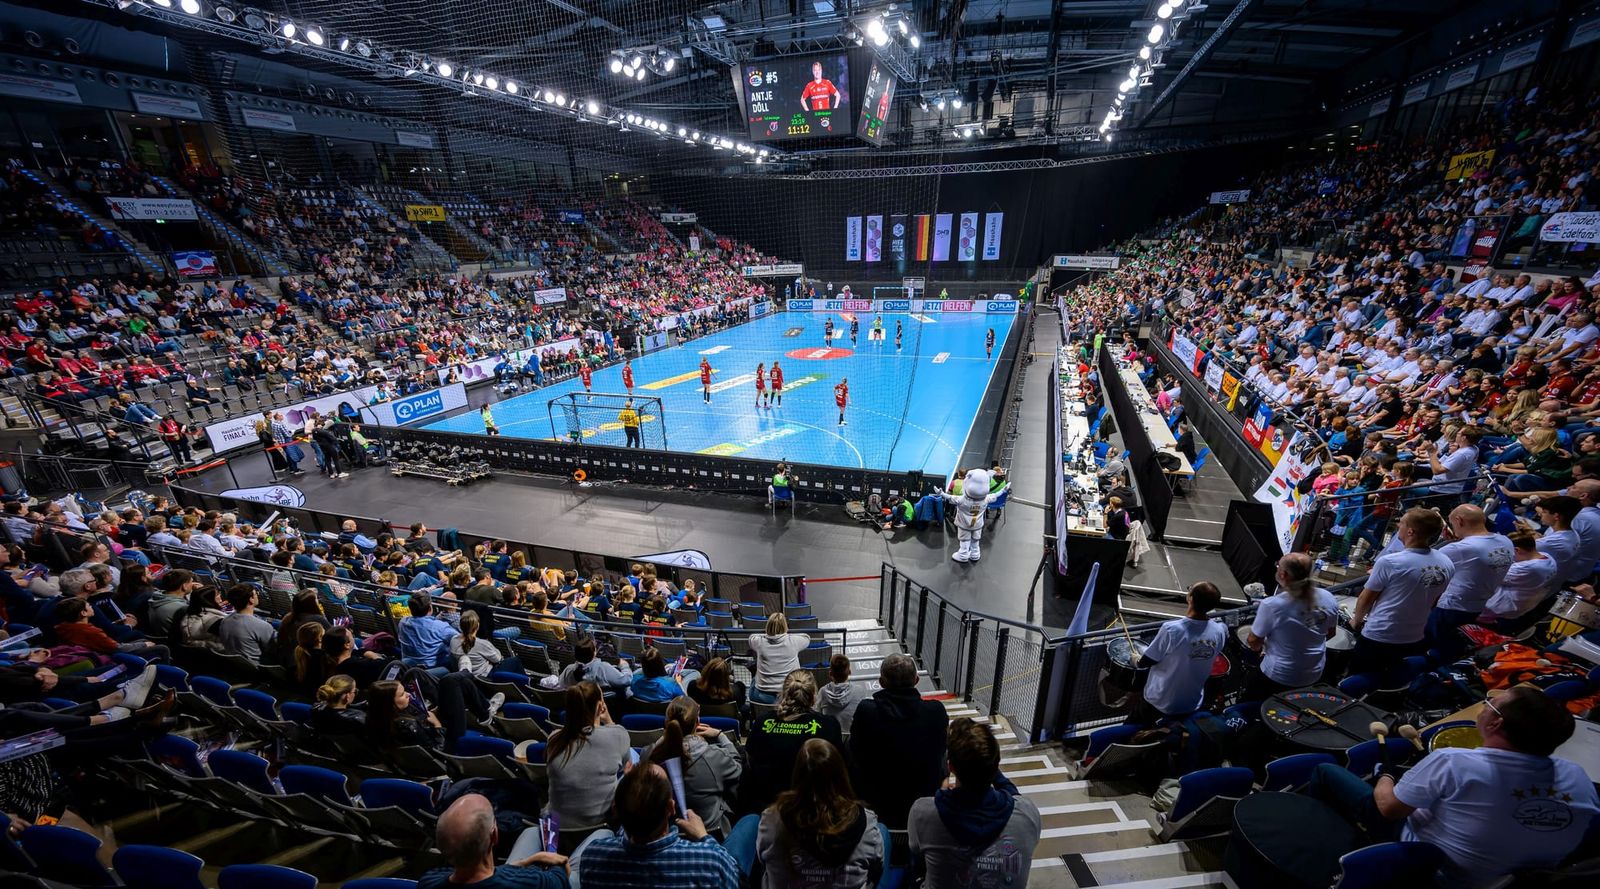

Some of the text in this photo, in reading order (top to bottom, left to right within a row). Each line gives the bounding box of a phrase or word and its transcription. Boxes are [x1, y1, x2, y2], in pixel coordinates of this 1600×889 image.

[766, 71, 778, 84] #5
[751, 91, 773, 101] ANTJE
[752, 102, 769, 112] DÖLL
[788, 125, 810, 135] 11:12
[414, 395, 441, 410] PLAN
[968, 510, 979, 528] 7
[847, 645, 879, 654] 16M3
[857, 661, 883, 670] 16M
